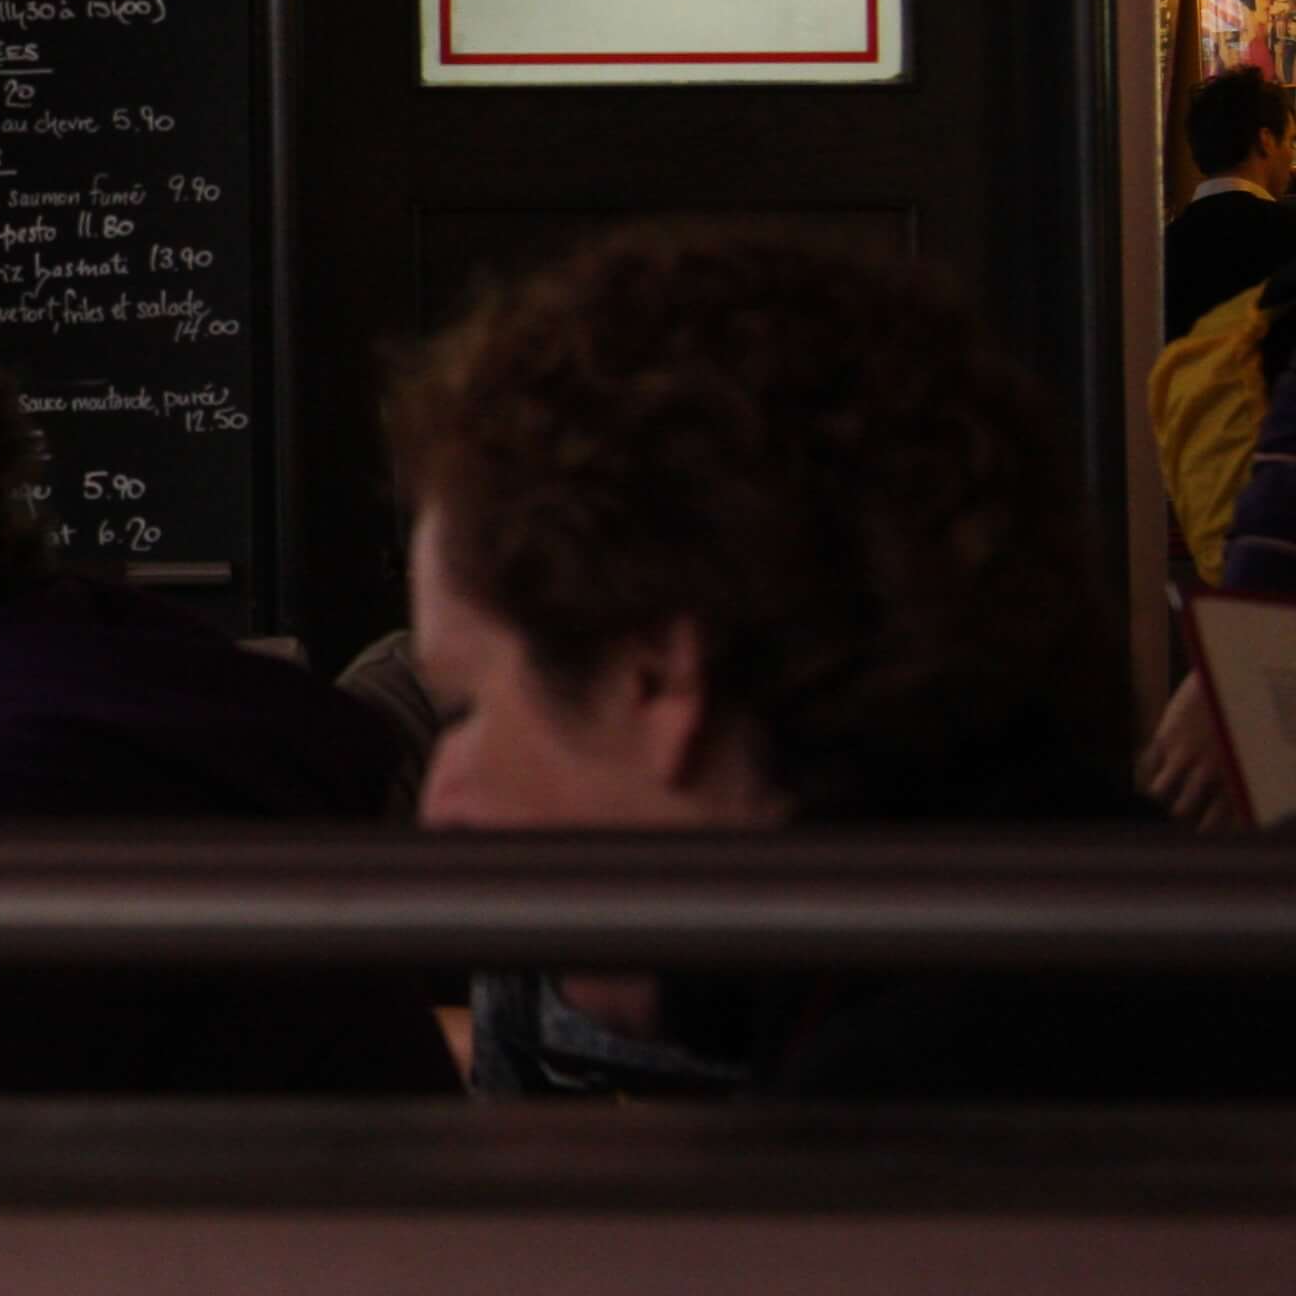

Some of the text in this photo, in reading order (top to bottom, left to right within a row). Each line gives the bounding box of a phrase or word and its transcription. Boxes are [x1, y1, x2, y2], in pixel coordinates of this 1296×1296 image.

[59, 0, 76, 21] à
[0, 117, 28, 134] au
[112, 105, 176, 134] 5.90
[167, 172, 222, 203] 9.90
[76, 210, 136, 240] 11.80
[32, 252, 129, 281] basmati
[148, 242, 214, 273] 13.90
[110, 292, 129, 320] et
[172, 318, 242, 344] 14.00
[184, 406, 250, 433] 12.50
[82, 470, 148, 500] 5.90
[96, 515, 163, 553] 6.20
